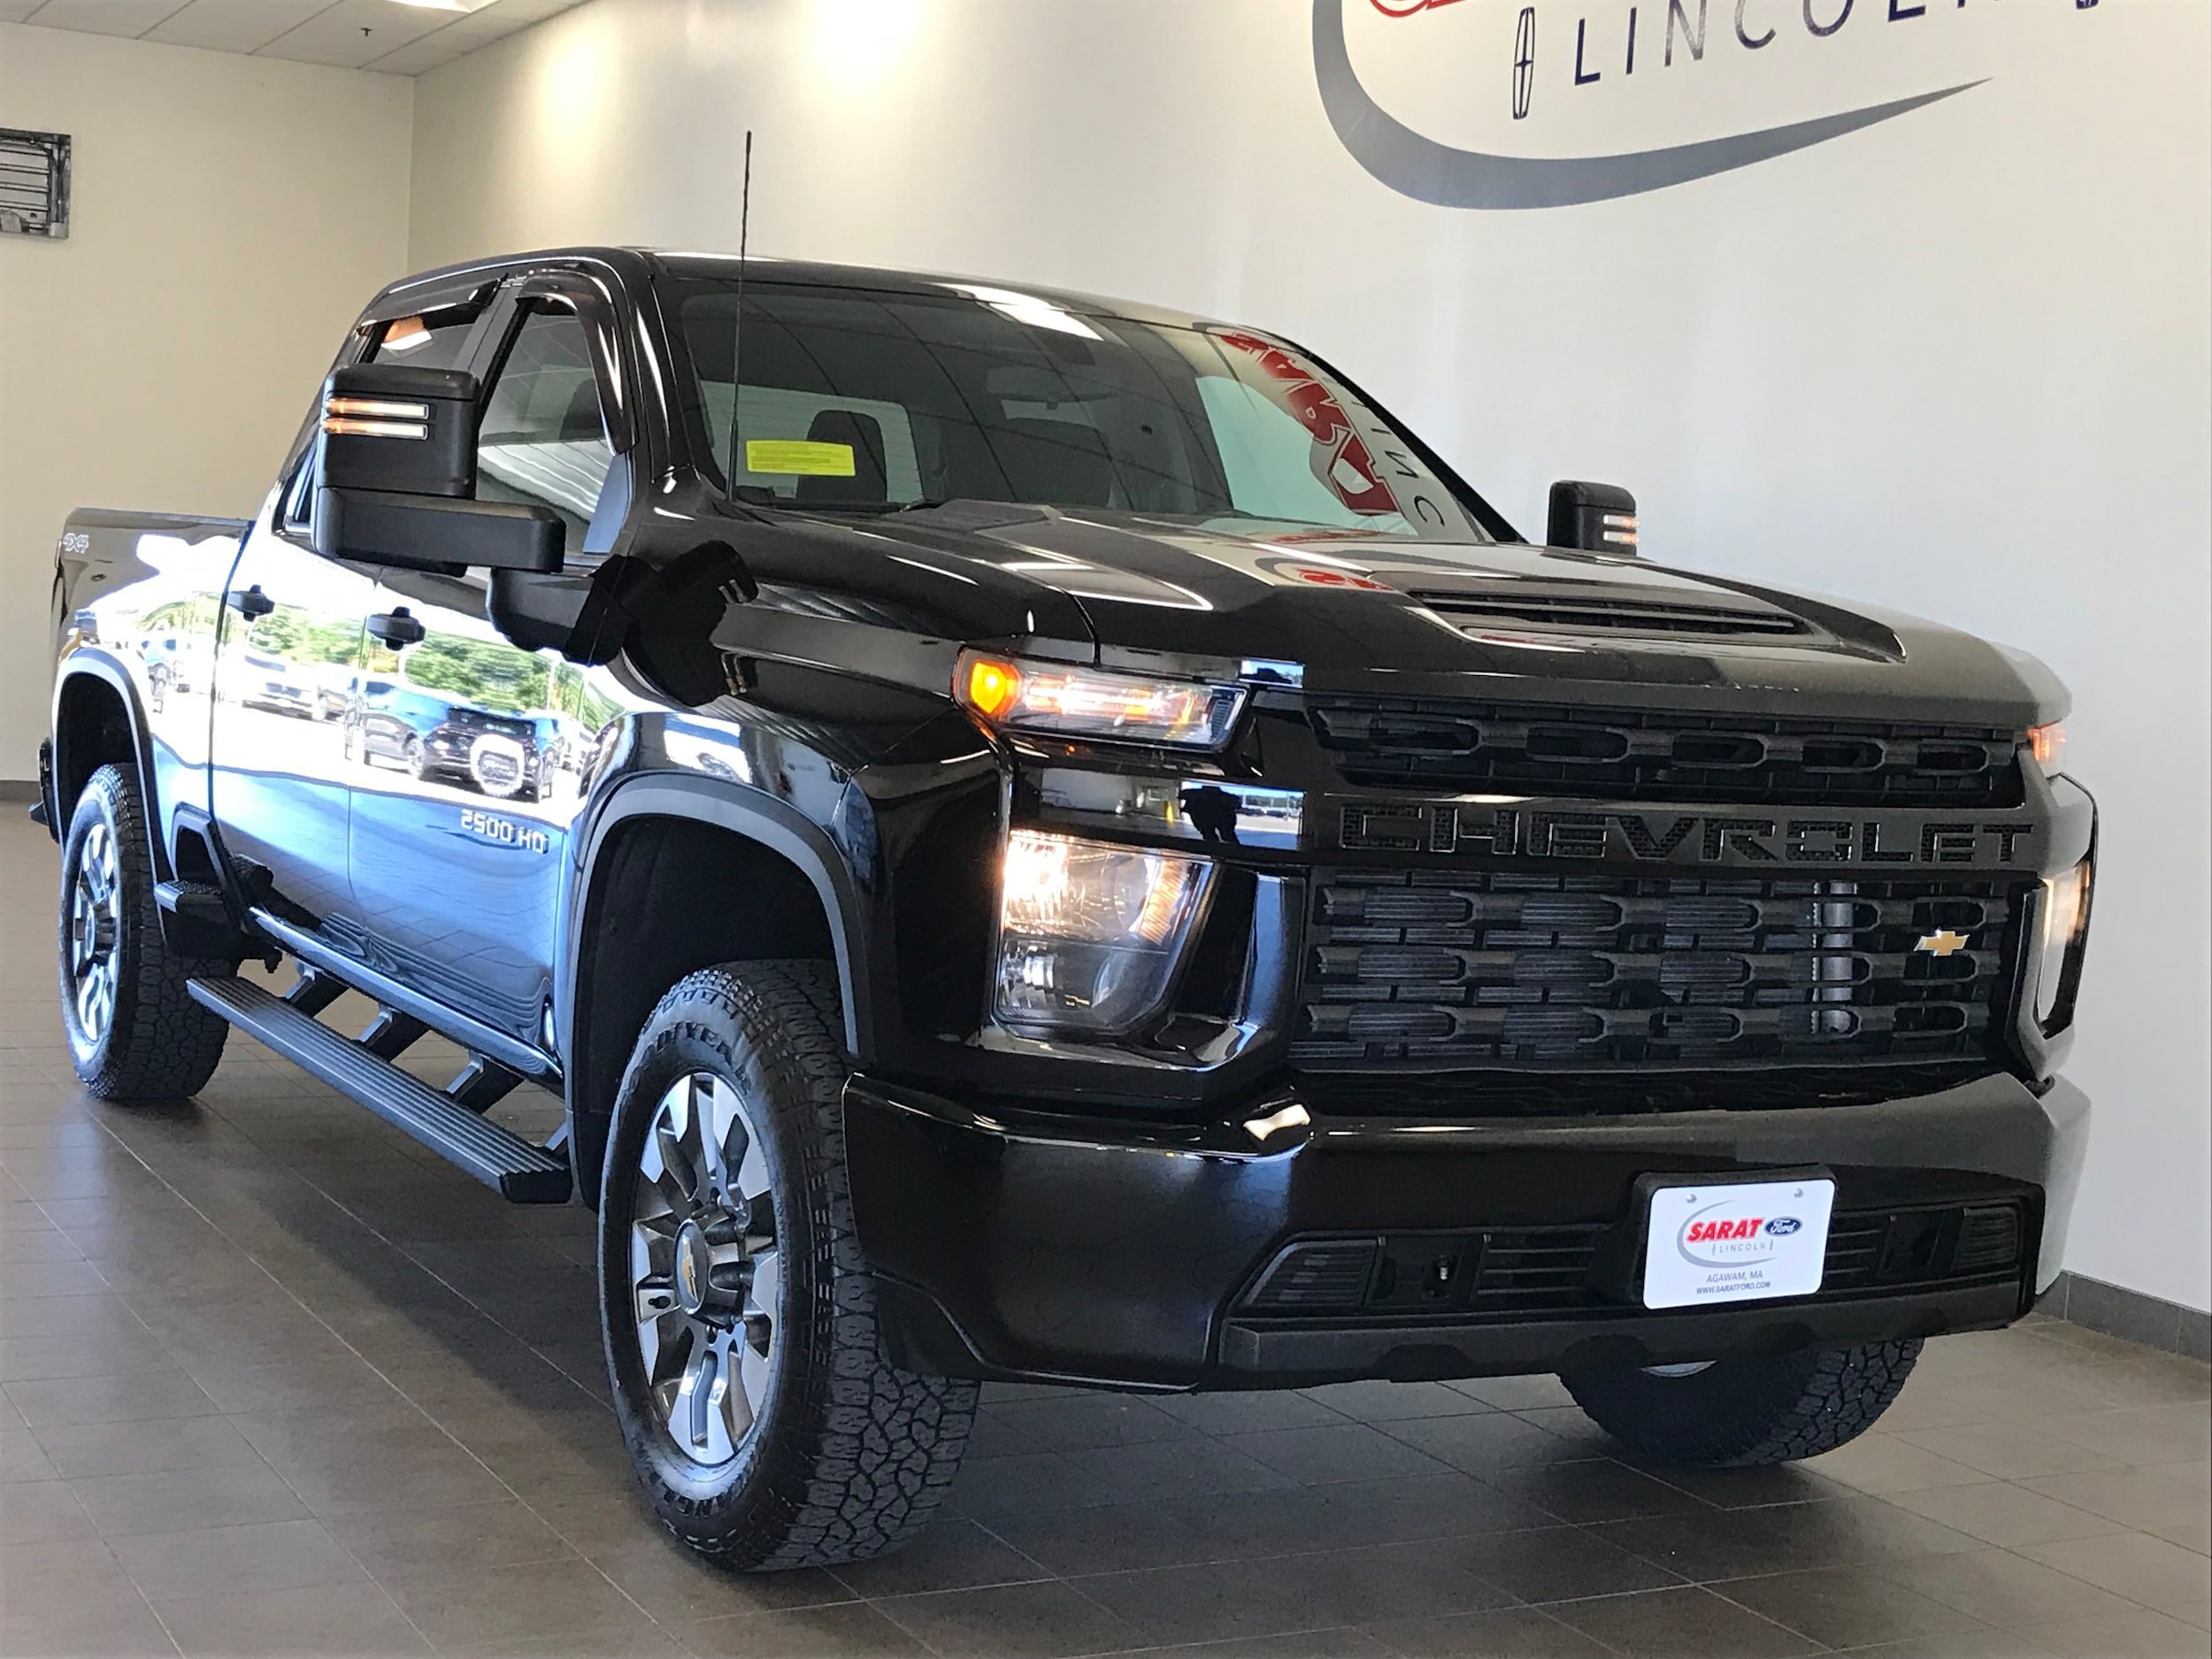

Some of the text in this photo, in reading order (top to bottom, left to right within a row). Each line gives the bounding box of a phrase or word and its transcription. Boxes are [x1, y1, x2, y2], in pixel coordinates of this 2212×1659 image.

[1574, 0, 2013, 86] LINCO
[461, 808, 549, 854] 2500 HD
[1339, 804, 2033, 863] CHEVROLET
[1686, 1217, 1800, 1243] SARAT Ford
[1719, 1242, 1767, 1254] LINCOLN
[1696, 1281, 1771, 1294] WWW.SARATFORD.COM
[1706, 1271, 1763, 1284] AGAWAM, MA
